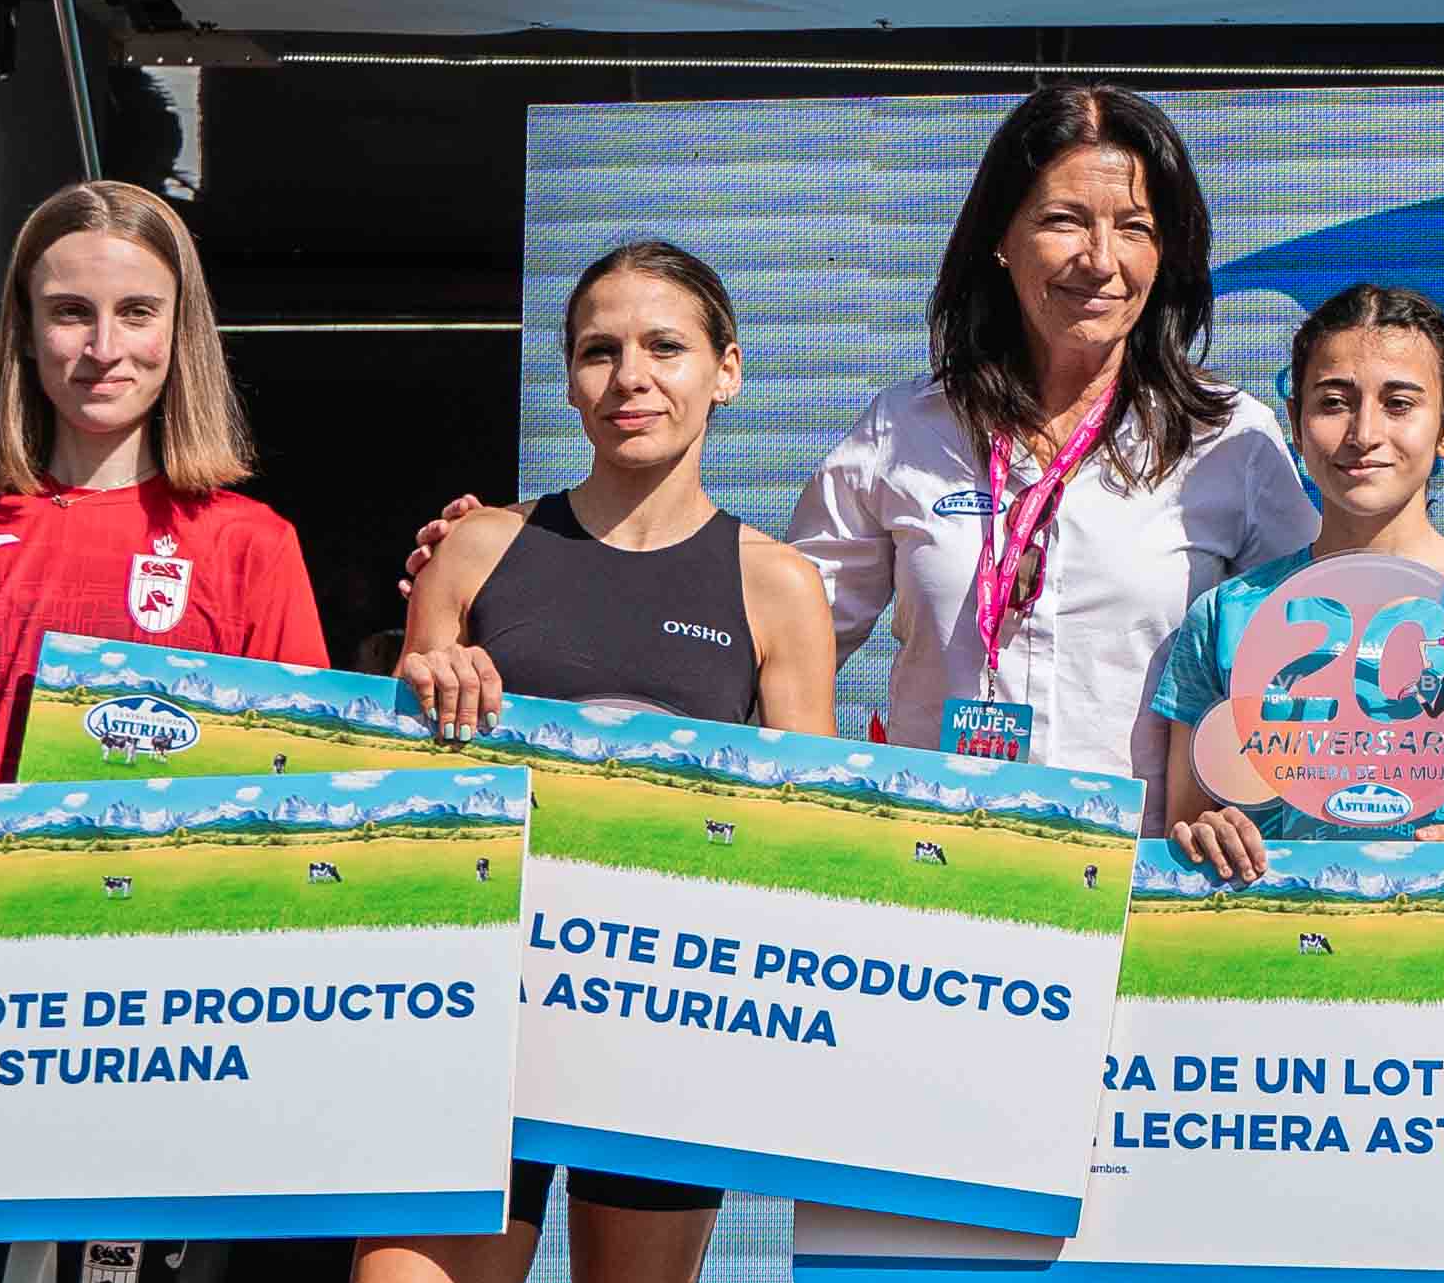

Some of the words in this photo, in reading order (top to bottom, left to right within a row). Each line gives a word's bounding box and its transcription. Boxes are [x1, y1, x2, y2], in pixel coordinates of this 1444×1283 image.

[663, 620, 732, 647] OYSHO
[953, 713, 1017, 733] MUJER
[1274, 765, 1350, 781] CARRERA
[1382, 765, 1404, 781] LA
[1332, 797, 1406, 815] ASTURIANA
[529, 912, 661, 965] LOTE
[673, 932, 740, 976] DE
[754, 943, 1073, 1022] PRODUCTOS
[83, 989, 149, 1028] DE
[162, 980, 476, 1025] PRODUCTOS
[542, 971, 837, 1047] ASTURIANA
[1172, 1055, 1238, 1093] DE
[1255, 1057, 1326, 1095] UN
[1113, 1111, 1350, 1153] LECHERA
[1089, 1164, 1131, 1175] ambios.
